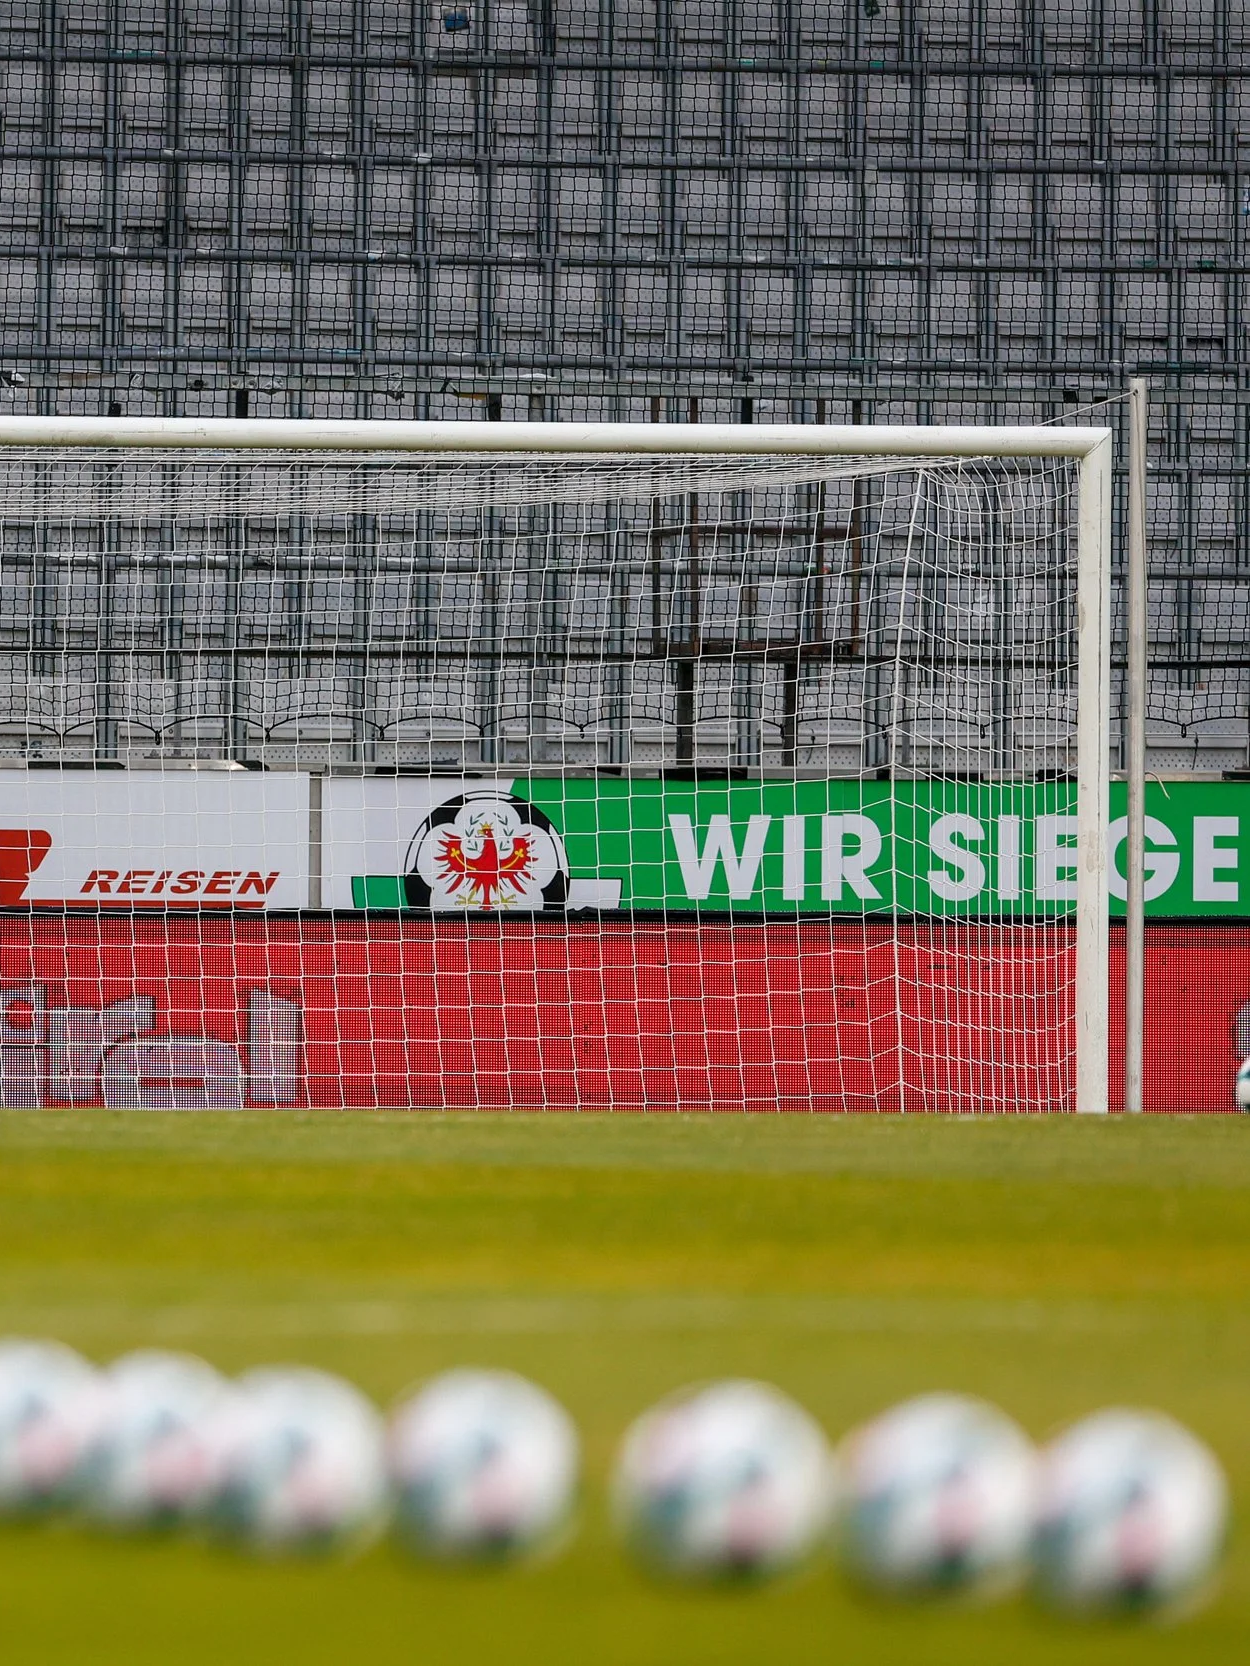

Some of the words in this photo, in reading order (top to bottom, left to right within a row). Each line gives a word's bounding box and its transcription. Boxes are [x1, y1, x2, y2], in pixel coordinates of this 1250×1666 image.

[79, 870, 280, 895] REISEN
[668, 813, 883, 900] WIR
[927, 813, 1240, 903] SIEGE
